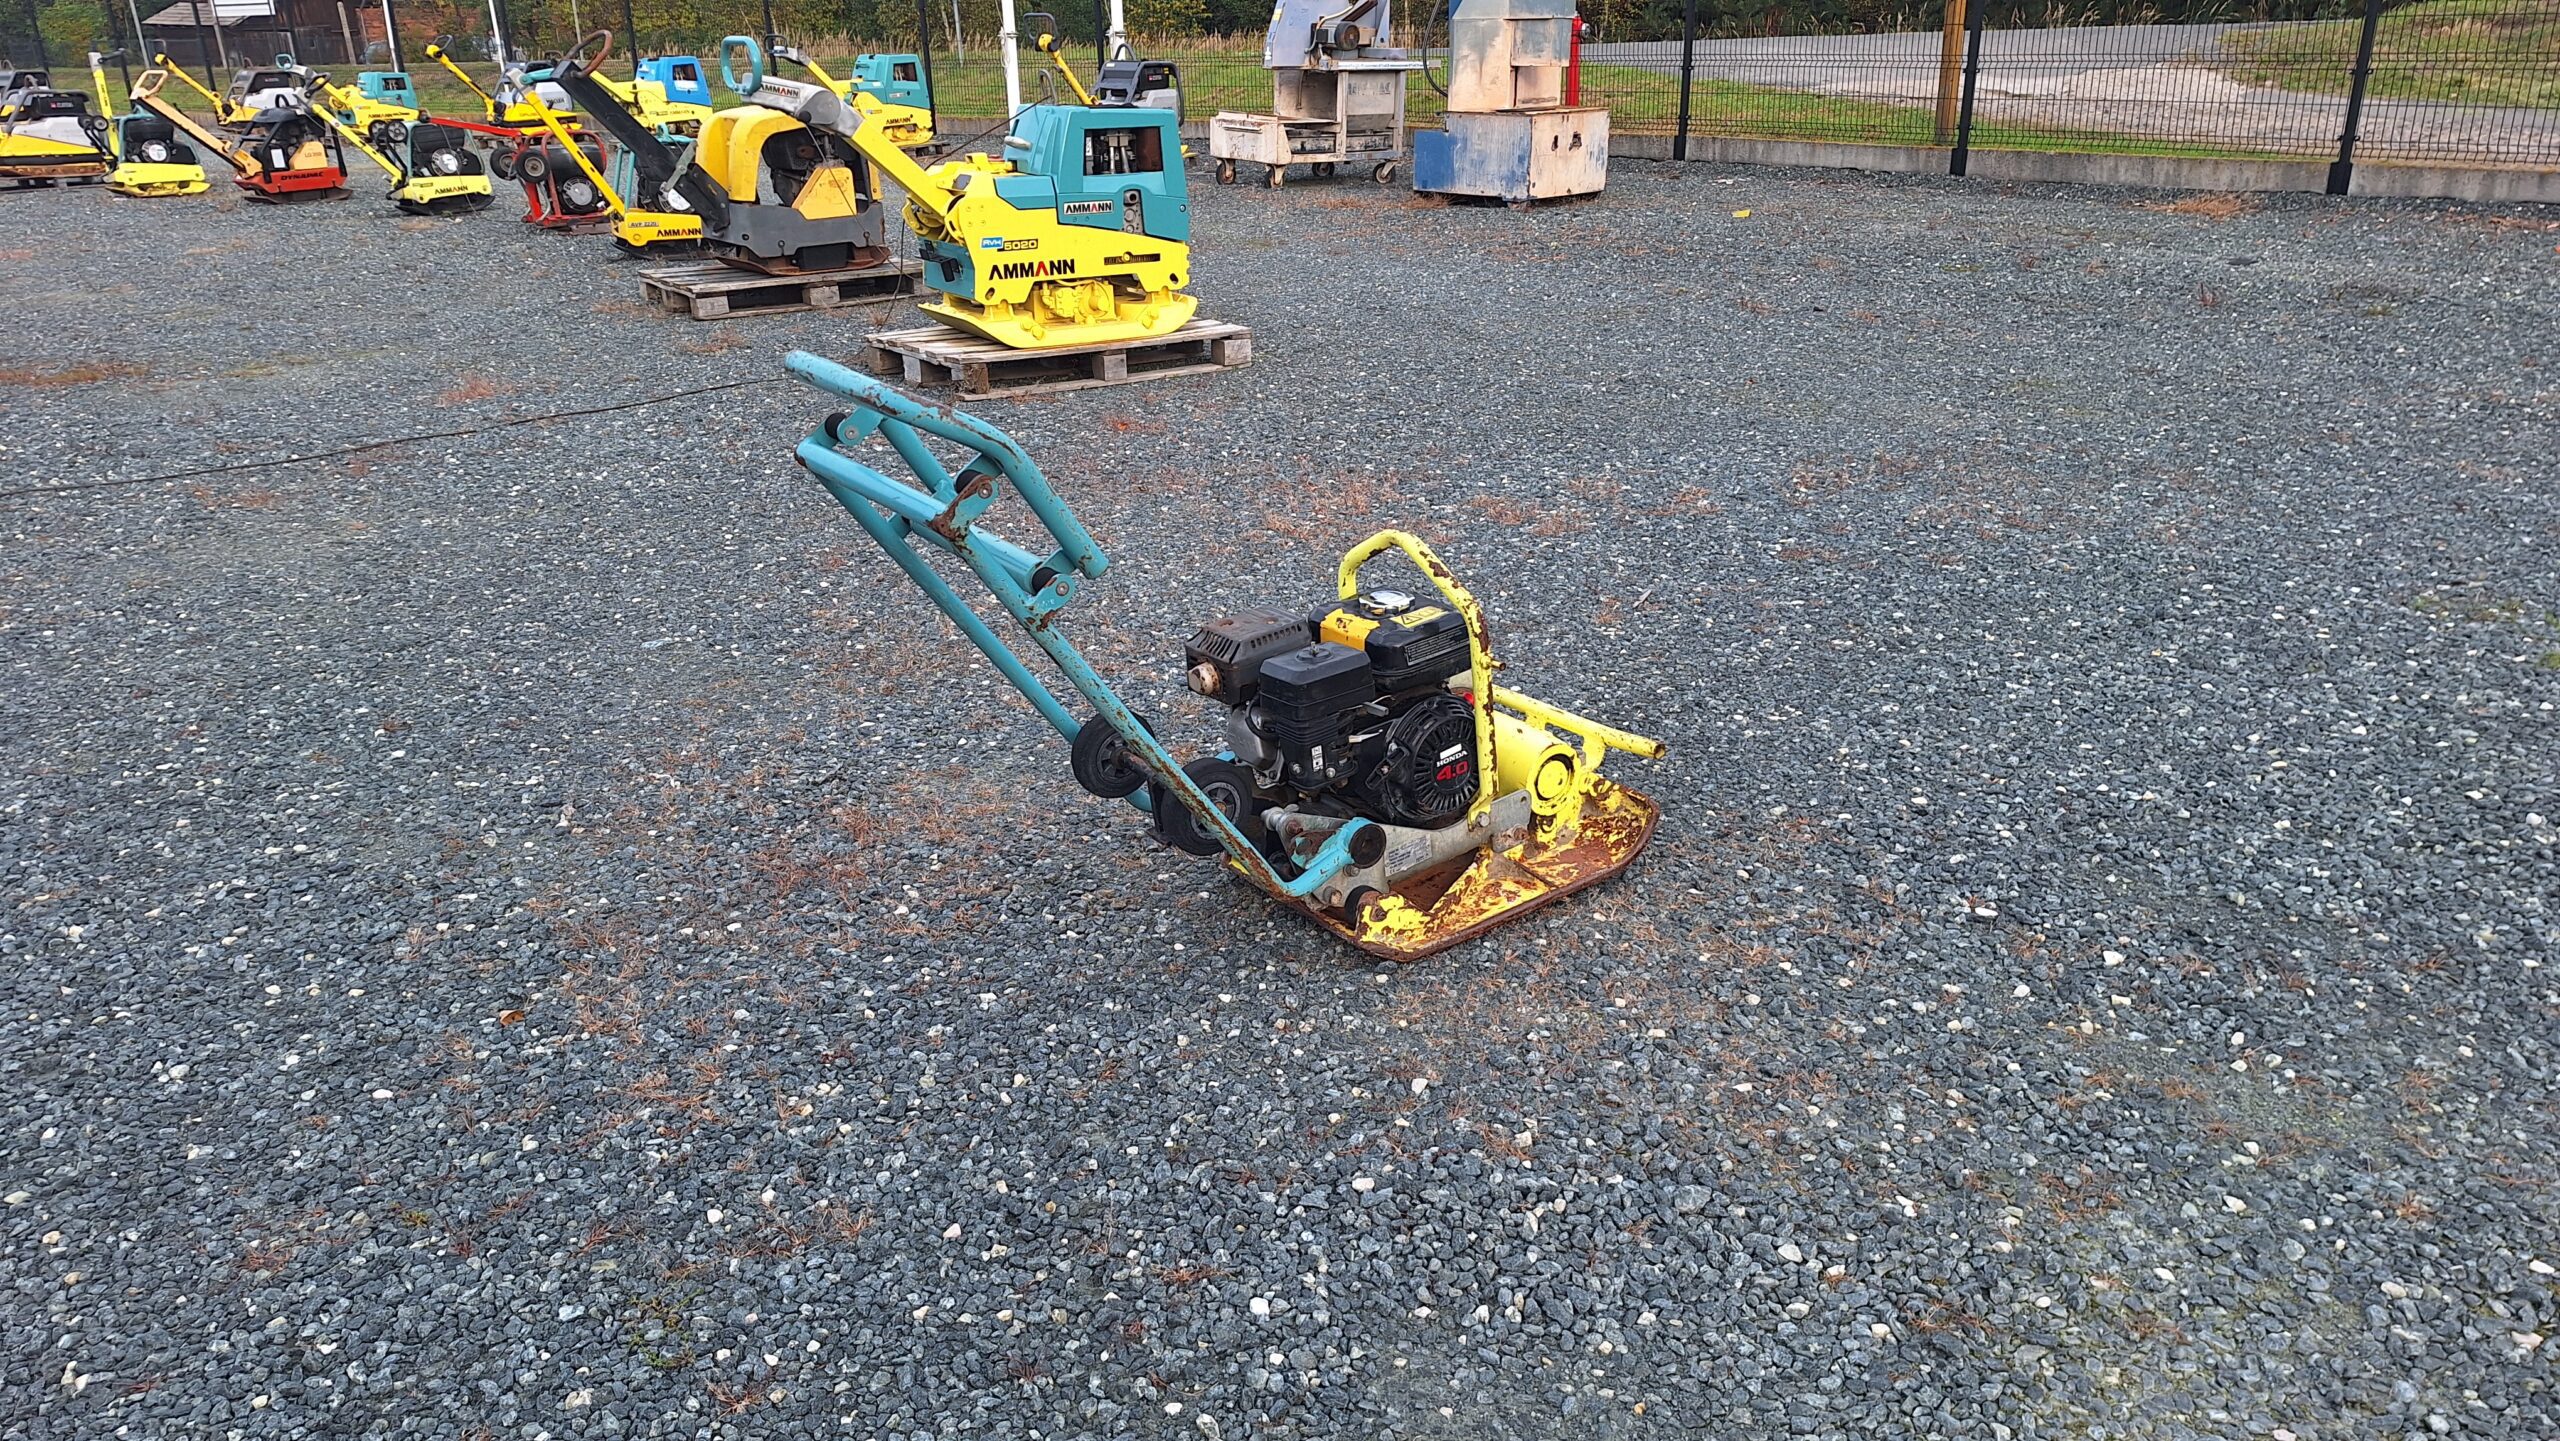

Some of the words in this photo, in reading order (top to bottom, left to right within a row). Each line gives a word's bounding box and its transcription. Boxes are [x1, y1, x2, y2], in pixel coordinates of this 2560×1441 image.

[434, 185, 469, 195] AMMANN
[1065, 201, 1112, 214] AMMANN
[656, 228, 702, 238] AMMANN
[1003, 239, 1037, 251] 5020
[988, 258, 1076, 281] AMMANN
[1436, 750, 1468, 768] HONDA
[1436, 760, 1469, 781] 4.0
